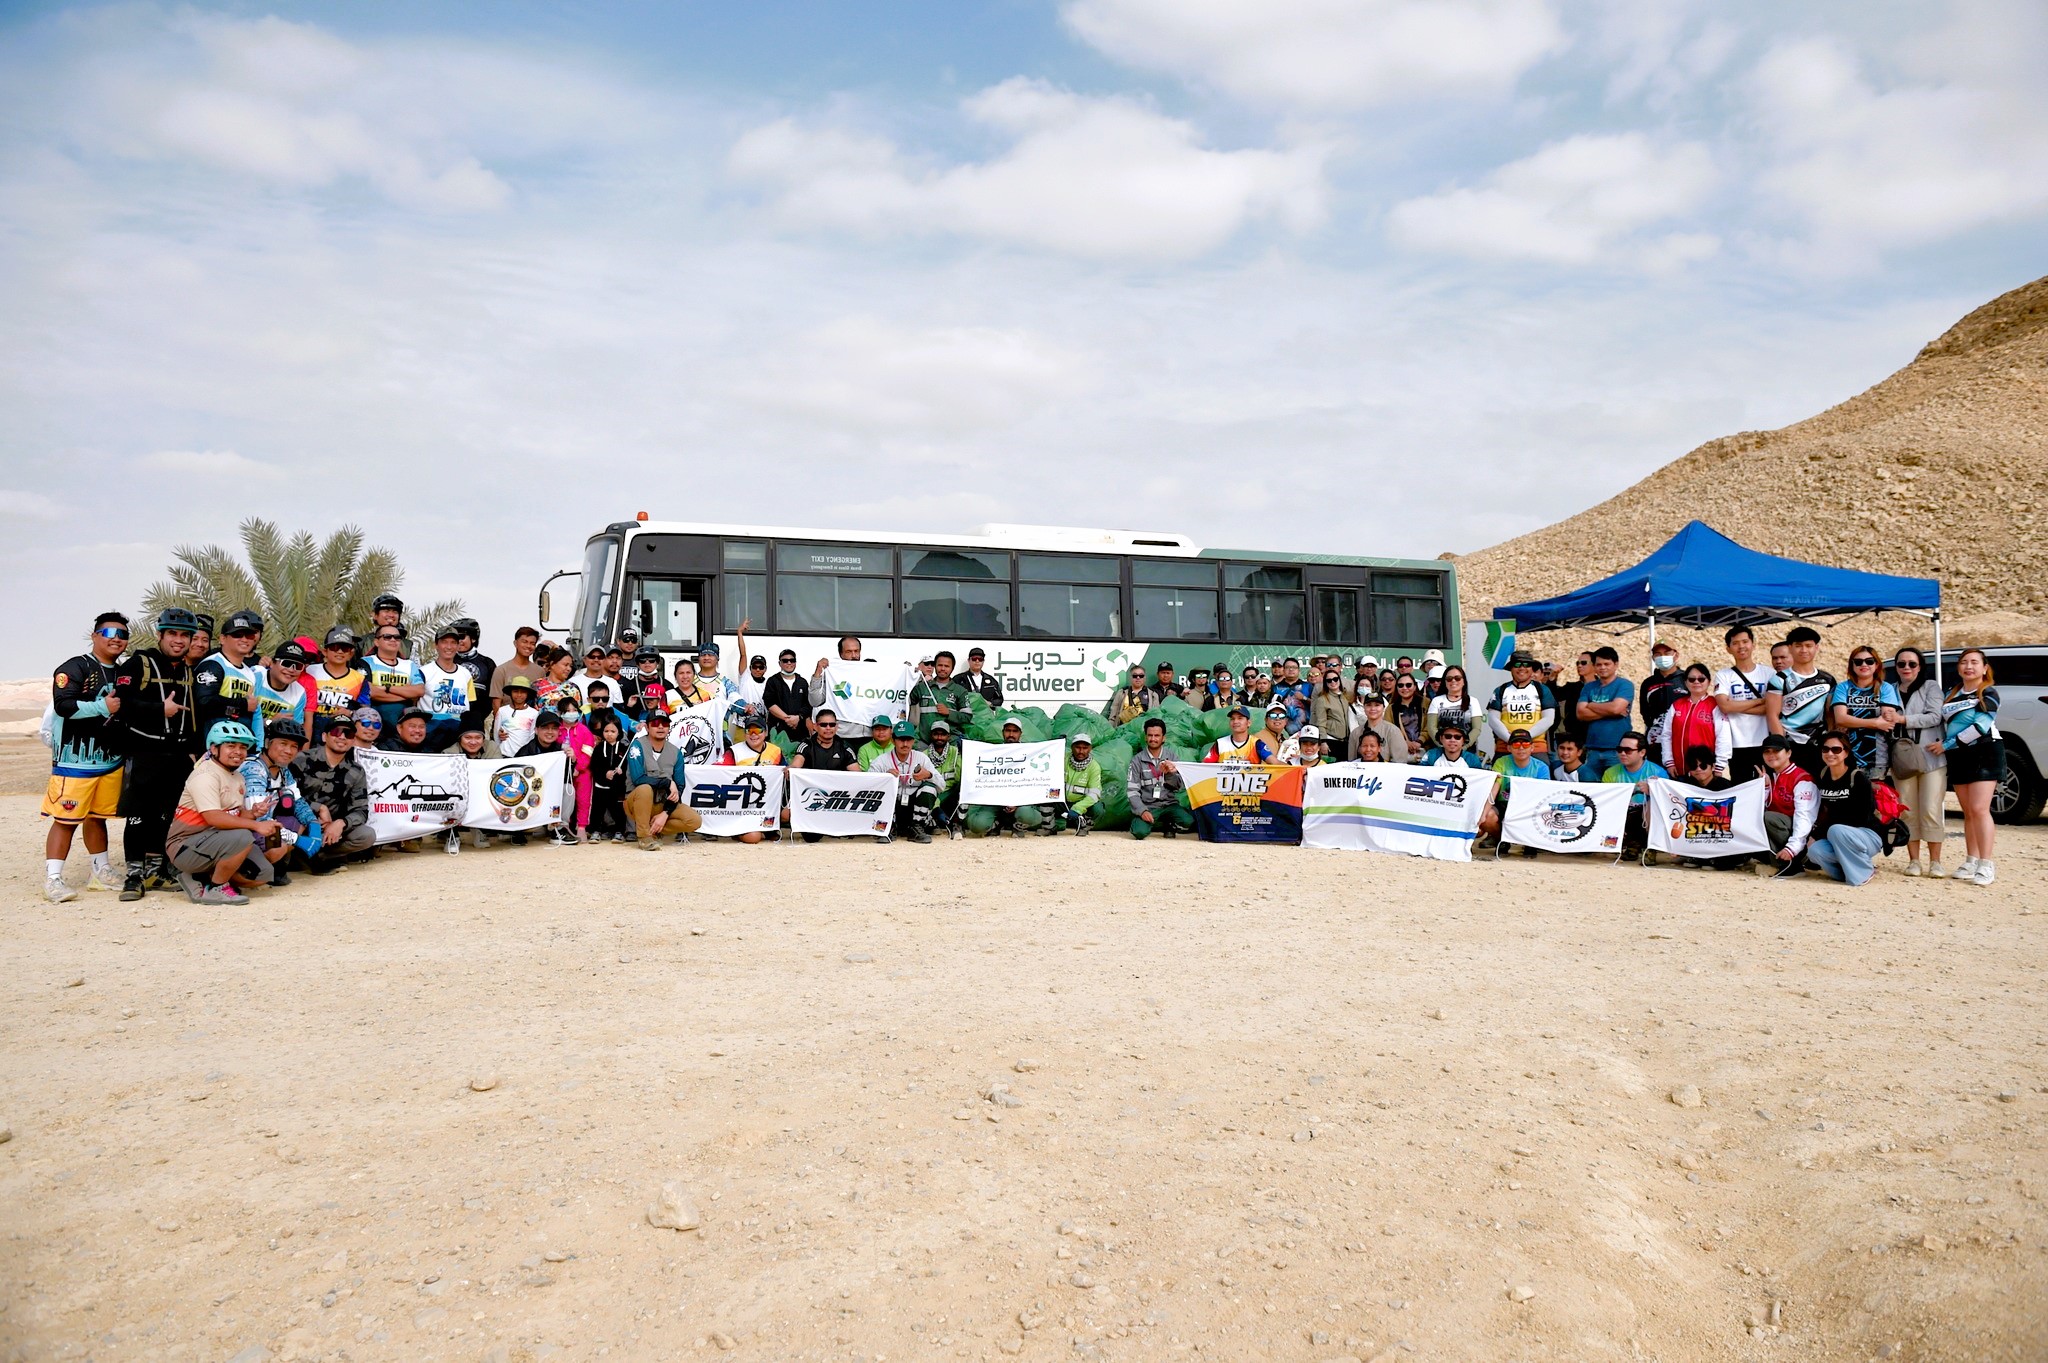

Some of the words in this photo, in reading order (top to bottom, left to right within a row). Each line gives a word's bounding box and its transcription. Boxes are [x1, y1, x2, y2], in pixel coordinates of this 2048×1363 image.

[994, 648, 1085, 671] تدوير
[994, 673, 1085, 692] Tadweer
[1510, 703, 1532, 711] UAE
[1510, 712, 1533, 720] MTB
[392, 759, 414, 767] XBOX
[976, 754, 1027, 765] تدوير
[976, 766, 1026, 775] Tadweer
[1216, 773, 1271, 793] ONE
[1324, 777, 1341, 788] BIKE
[1342, 778, 1356, 788] FOR
[1356, 774, 1383, 796] Life
[824, 798, 882, 812] MTB
[1221, 796, 1239, 806] AL
[1239, 796, 1261, 806] AIN
[374, 803, 409, 813] VERTIZON
[411, 803, 455, 813] OFFROADERS
[1233, 816, 1241, 825] 6
[1687, 823, 1732, 835] STYLE
